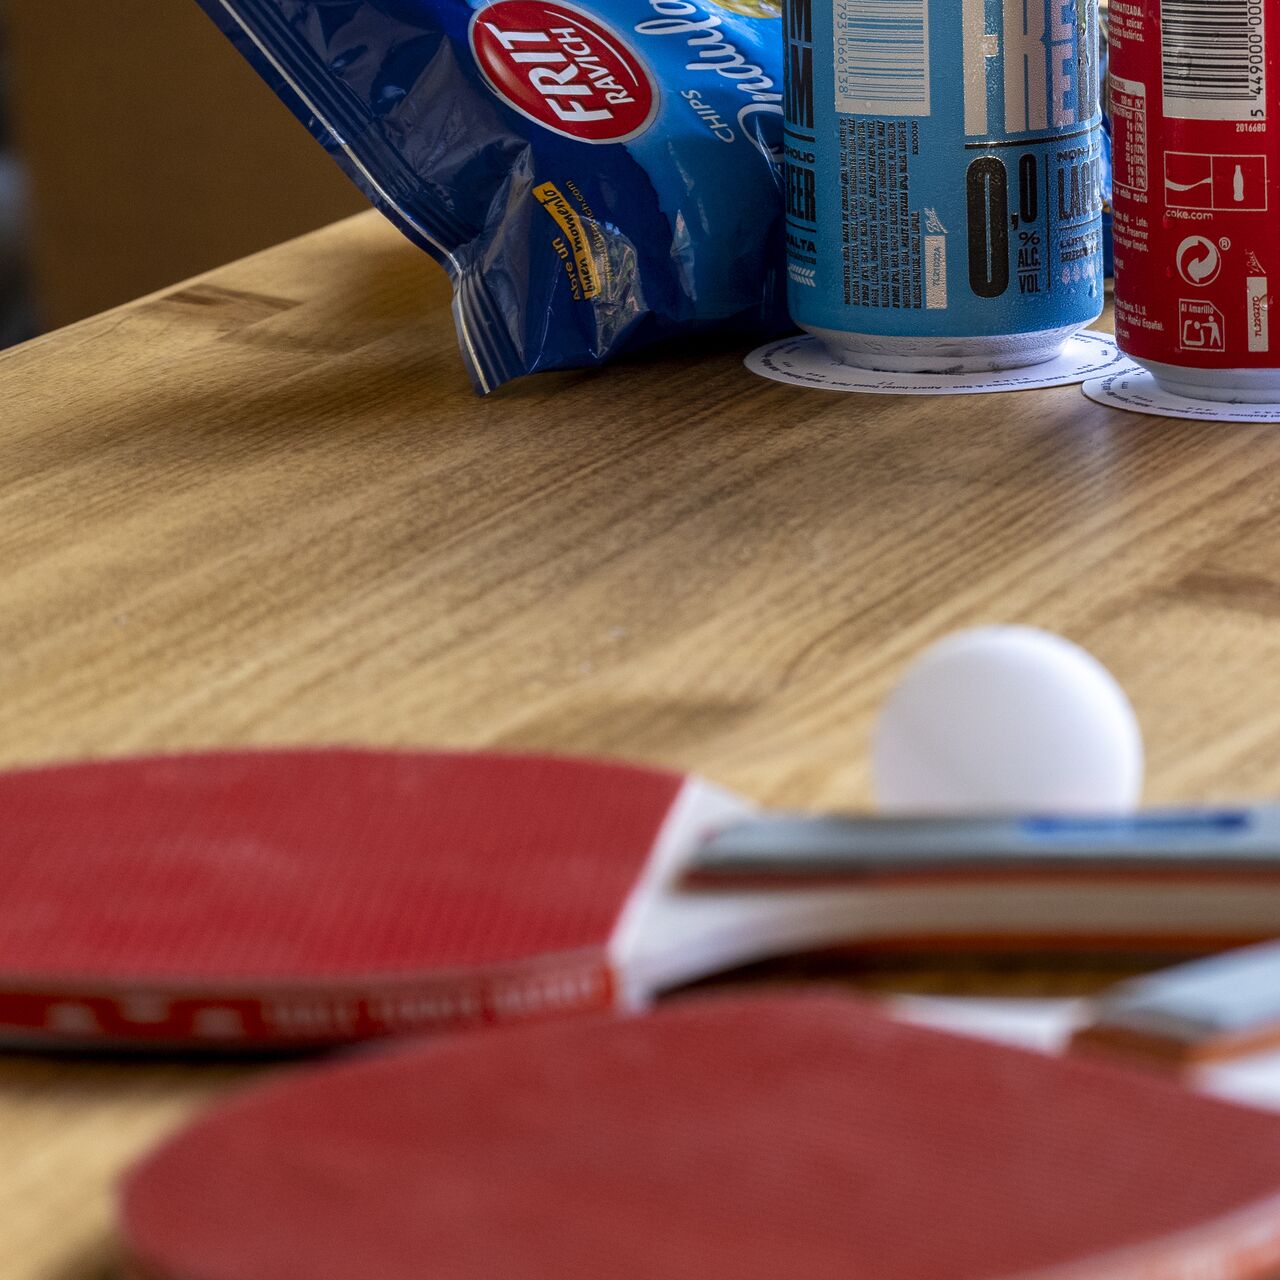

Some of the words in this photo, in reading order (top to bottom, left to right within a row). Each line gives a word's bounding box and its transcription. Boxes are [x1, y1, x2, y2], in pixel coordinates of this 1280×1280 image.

[483, 22, 614, 122] FRIT
[550, 27, 636, 105] RAVICH
[837, 36, 849, 95] 066138
[1250, 34, 1263, 96] 449000
[680, 88, 736, 144] CHIPS
[1251, 109, 1264, 117] 5
[541, 188, 583, 253] momento
[1166, 209, 1214, 221] coke.com
[552, 237, 570, 260] un
[565, 261, 581, 302] Abre
[578, 257, 595, 296] buen
[1019, 273, 1042, 294] VOL
[1181, 302, 1188, 312] Al
[1188, 304, 1215, 315] Amarillo
